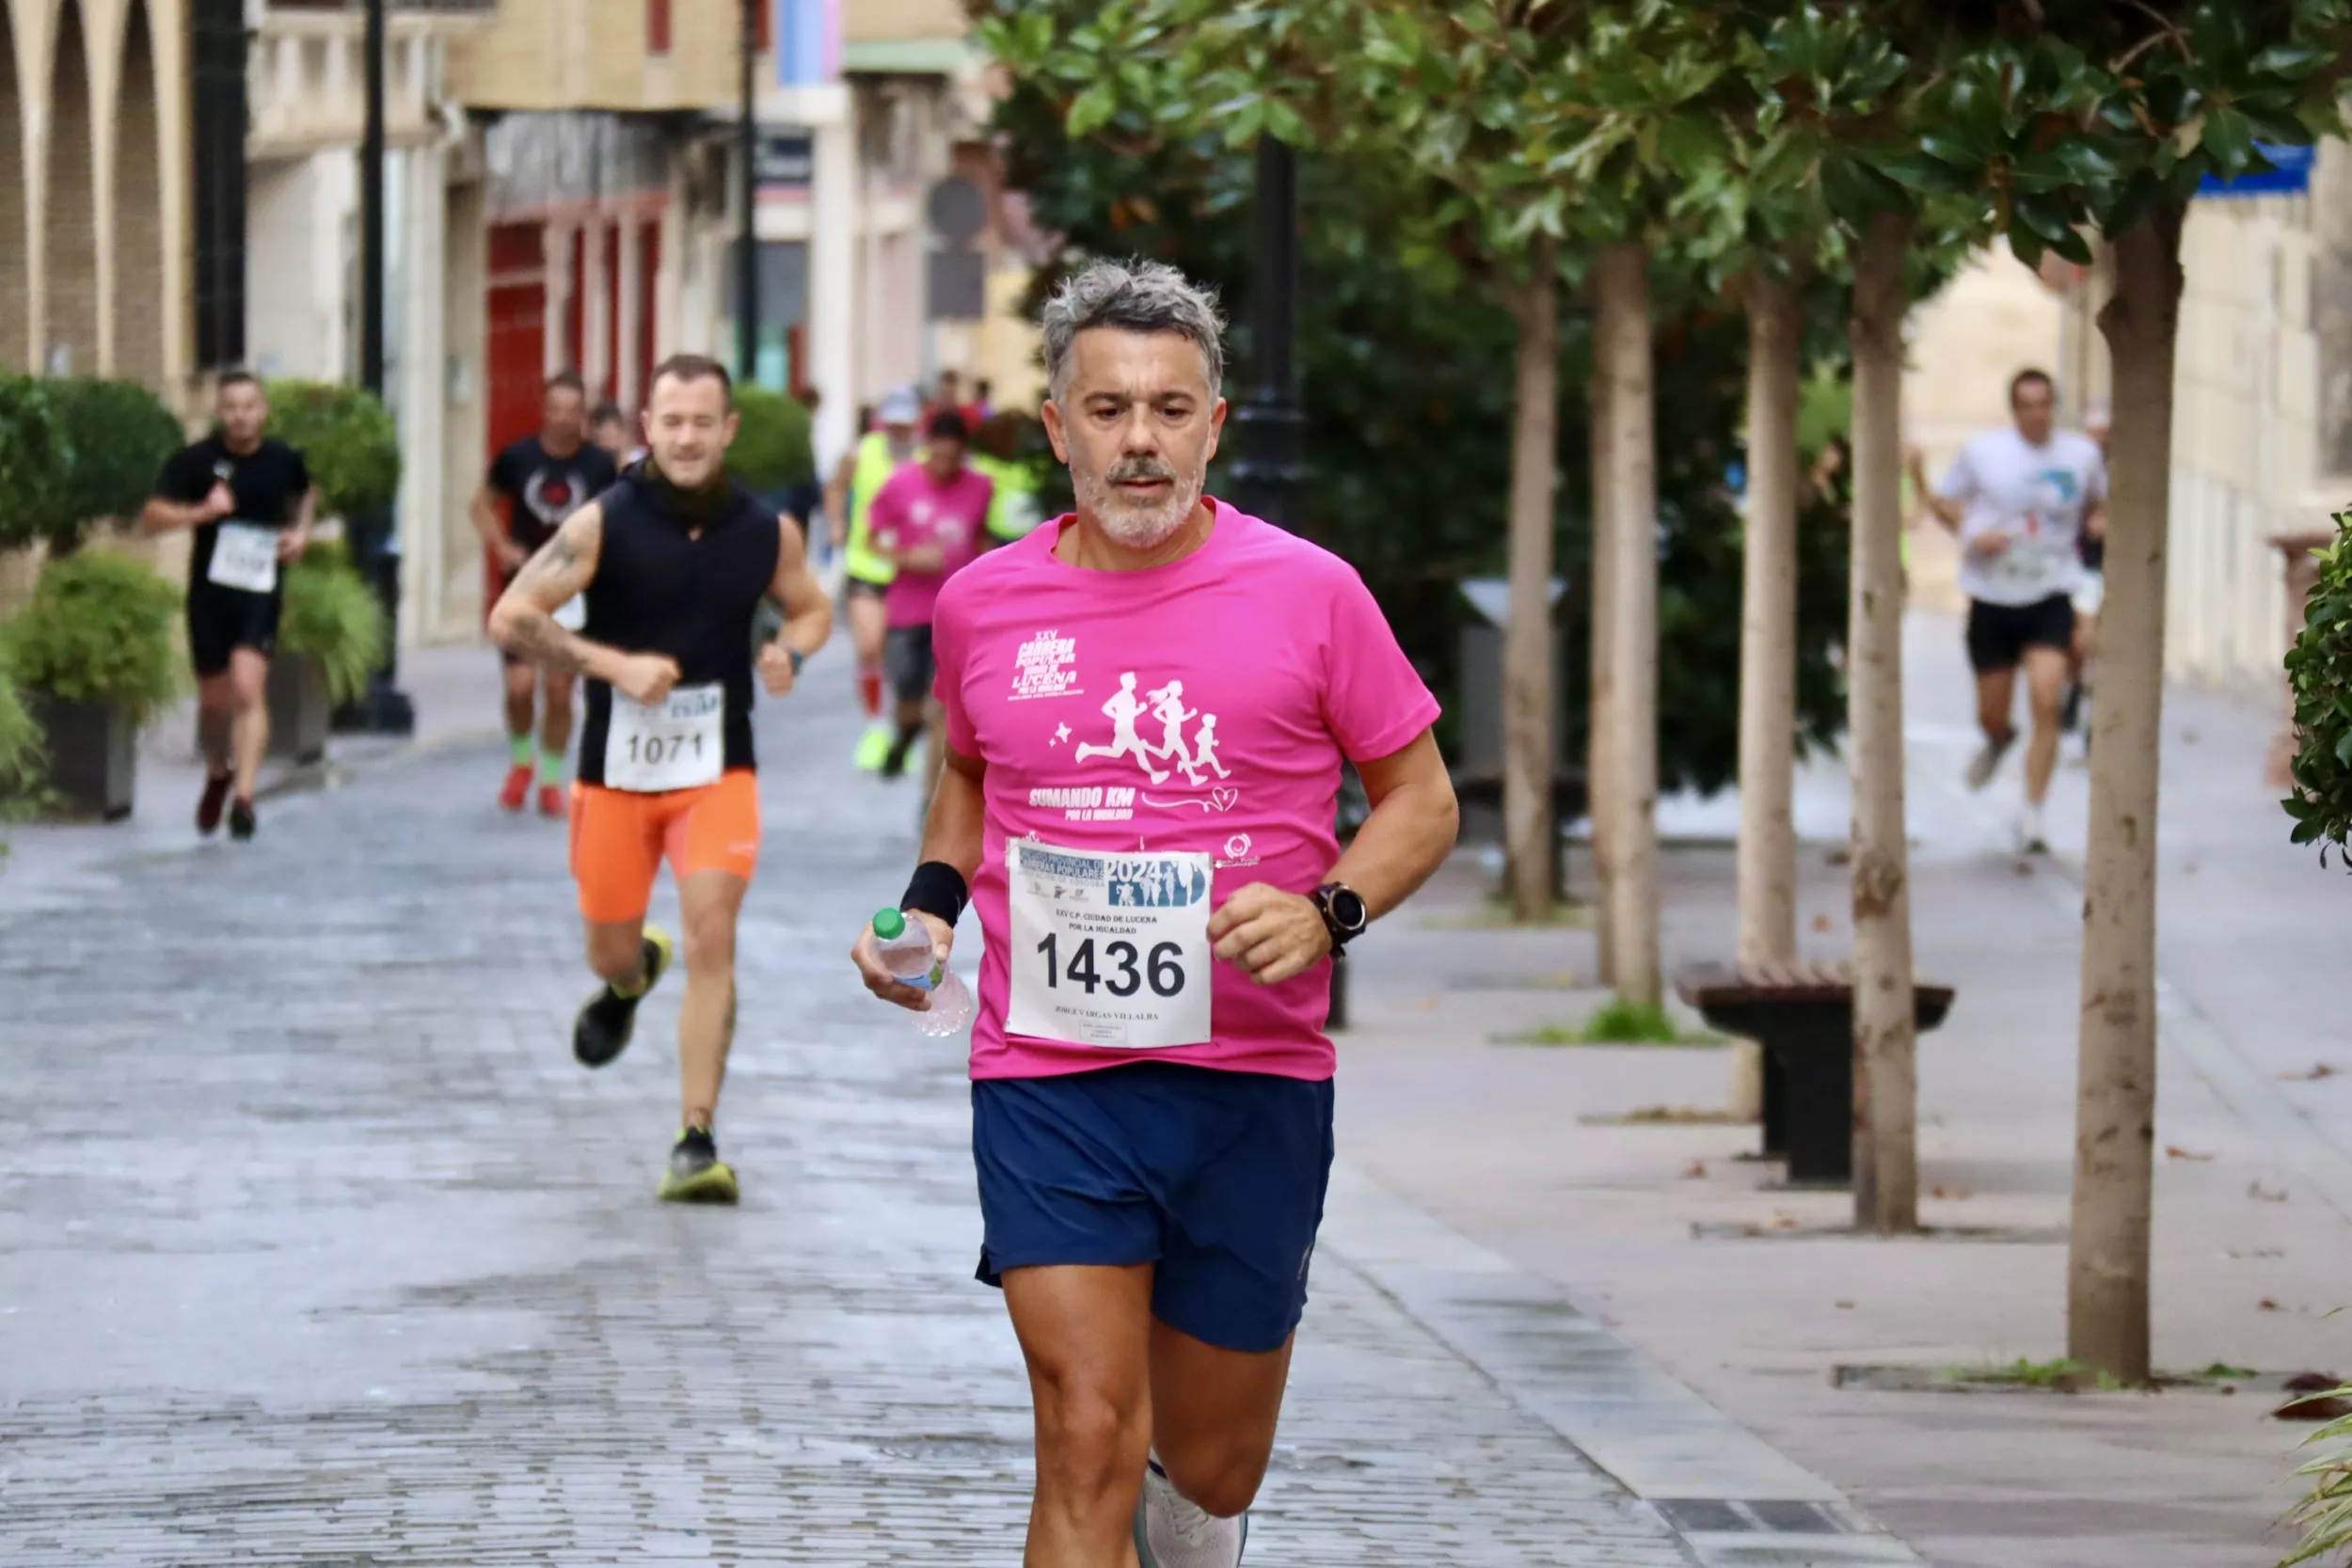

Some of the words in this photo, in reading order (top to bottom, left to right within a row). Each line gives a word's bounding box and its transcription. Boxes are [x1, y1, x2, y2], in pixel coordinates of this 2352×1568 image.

[1011, 670, 1077, 689] LUCENA
[626, 732, 702, 765] 1071
[1029, 786, 1103, 807] SUMANDO
[1105, 786, 1136, 807] KM
[1057, 863, 1105, 879] POPULARES
[1108, 859, 1163, 882] 2024
[1083, 913, 1111, 922] CIUDAD
[1095, 926, 1136, 934] IGUALDAD
[1037, 932, 1185, 997] 1436
